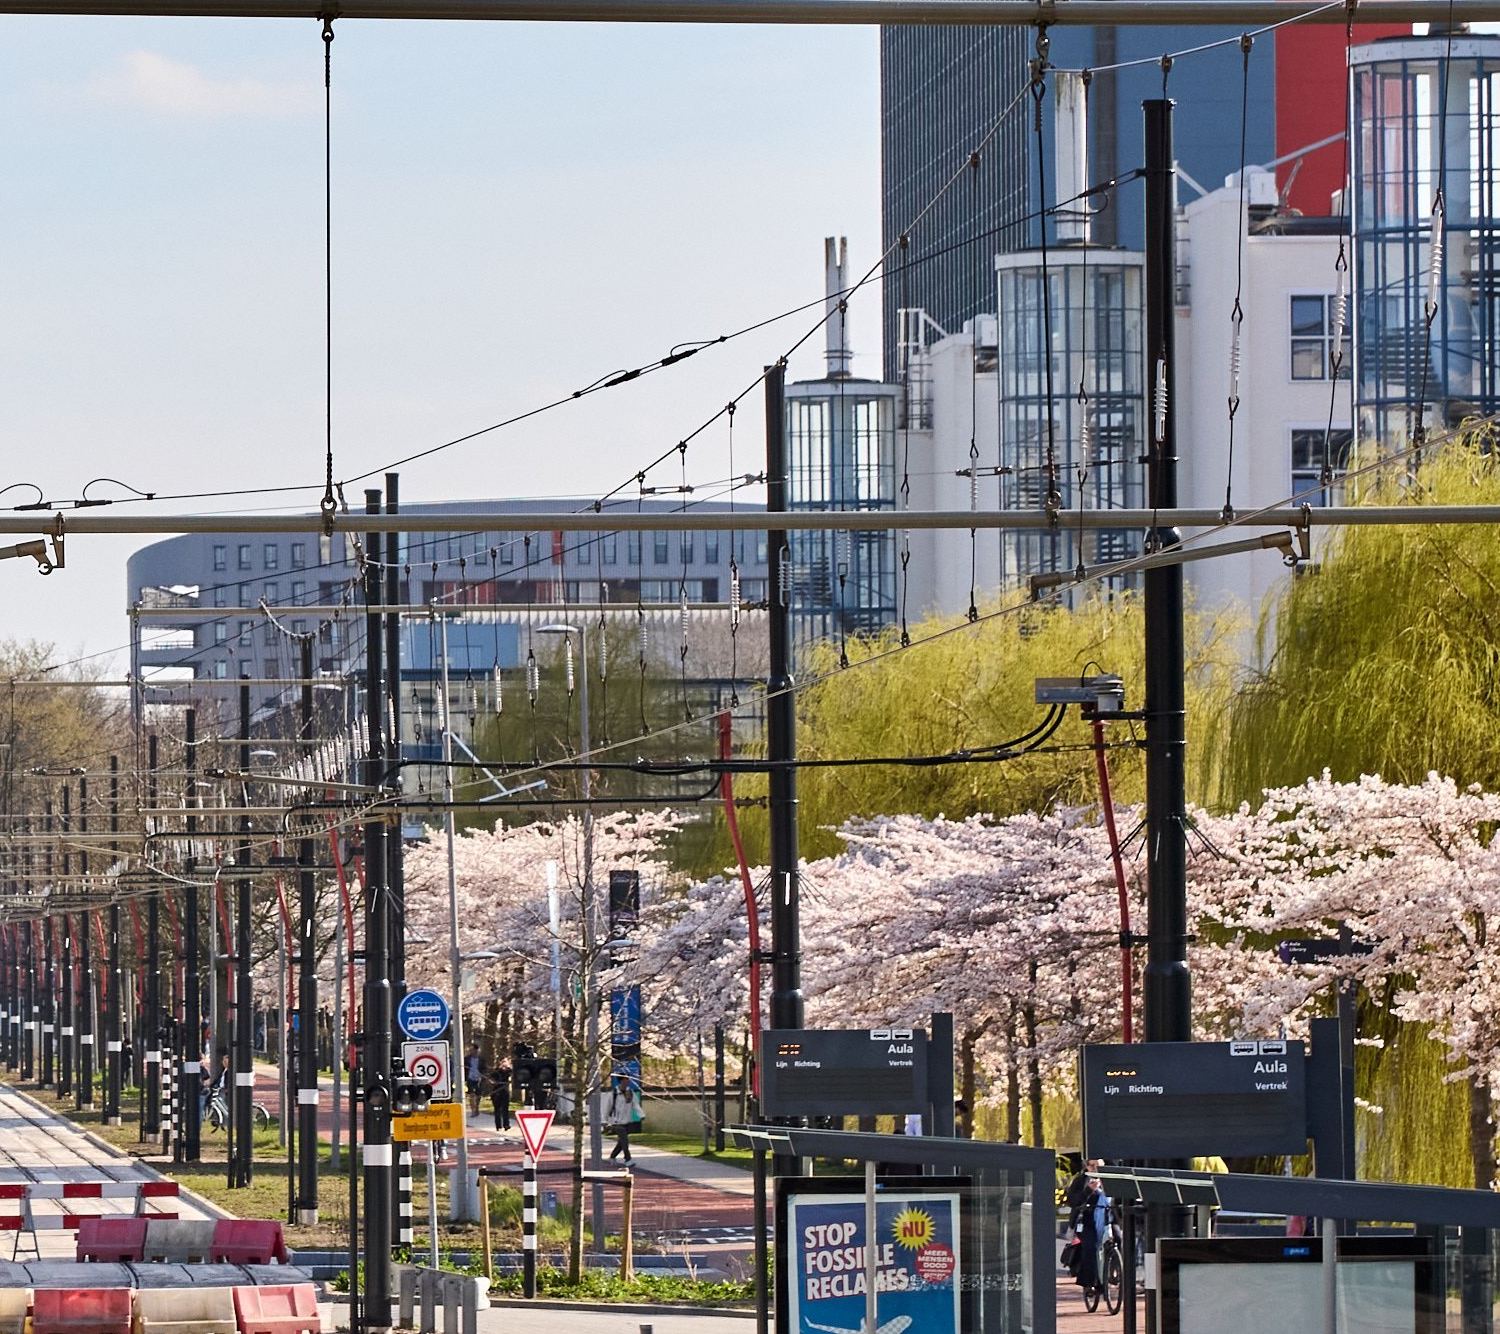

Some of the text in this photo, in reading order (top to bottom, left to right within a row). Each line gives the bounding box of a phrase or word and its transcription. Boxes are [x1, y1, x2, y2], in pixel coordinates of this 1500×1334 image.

[888, 1043, 914, 1054] Aula
[416, 1064, 437, 1077] 30
[776, 1059, 913, 1069] Lijn Richting Vertrek
[1254, 1060, 1288, 1074] Aula
[1104, 1081, 1287, 1096] Lijn Richting Vertrek
[804, 1221, 857, 1249] STOP
[902, 1220, 925, 1238] NU
[805, 1243, 894, 1275] FOSSILE
[918, 1255, 953, 1264] MENSEN
[924, 1249, 948, 1257] MEER
